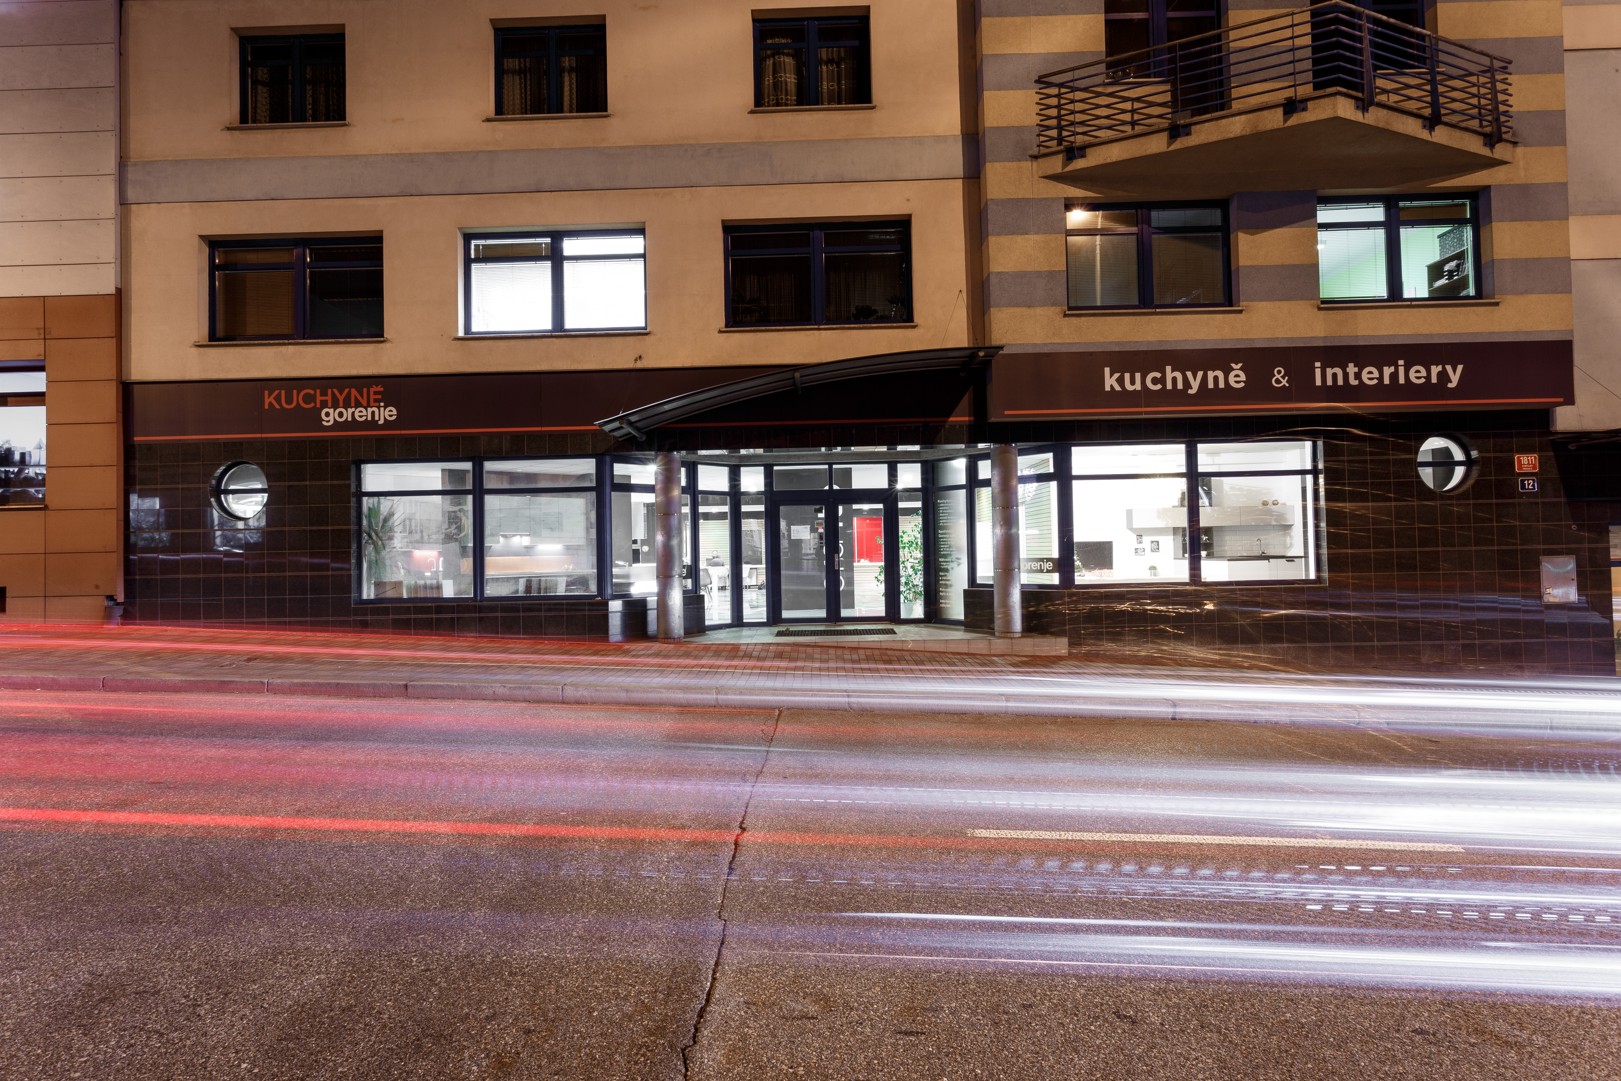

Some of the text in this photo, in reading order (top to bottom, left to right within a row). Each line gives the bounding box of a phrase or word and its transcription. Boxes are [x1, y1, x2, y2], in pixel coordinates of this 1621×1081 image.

[1103, 359, 1464, 395] kuchyně & interiery
[263, 385, 385, 410] KUCHYNĚ
[320, 402, 397, 426] gorenje
[1520, 456, 1535, 465] 1811
[1523, 479, 1534, 489] 12
